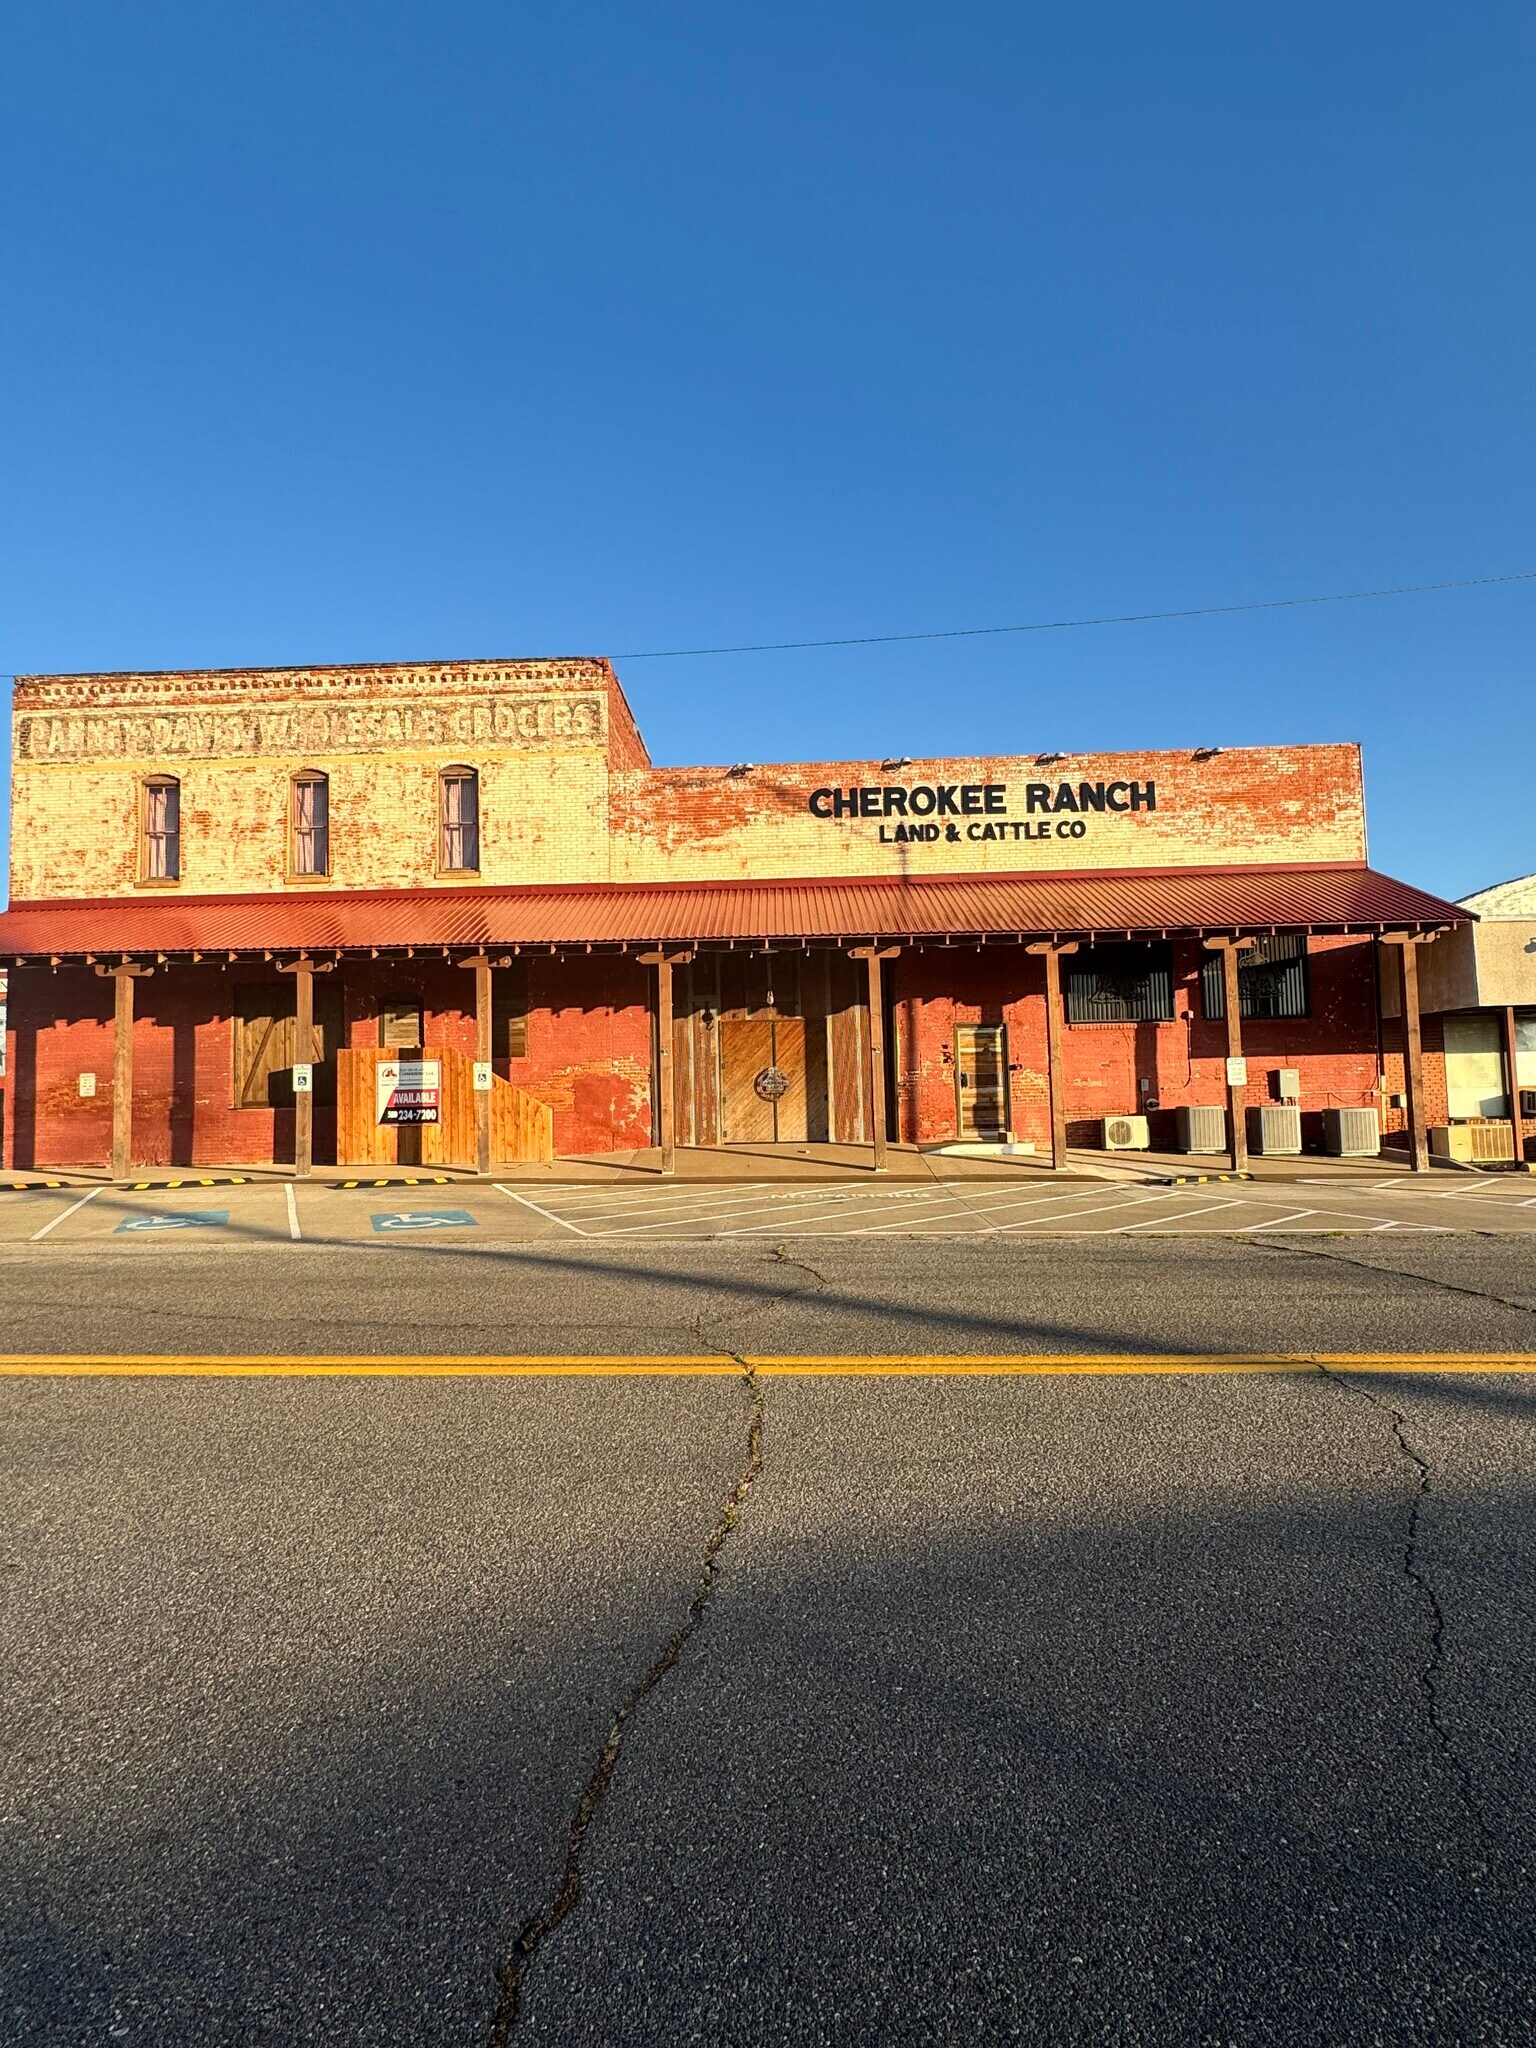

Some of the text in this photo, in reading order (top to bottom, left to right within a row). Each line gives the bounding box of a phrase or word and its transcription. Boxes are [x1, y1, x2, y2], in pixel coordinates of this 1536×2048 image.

[453, 702, 598, 739] GROCERS
[808, 781, 1156, 819] CHEROKEE RANCH
[879, 820, 1087, 843] LAND & CATTLE CO
[394, 1092, 436, 1104] AVAILABLE
